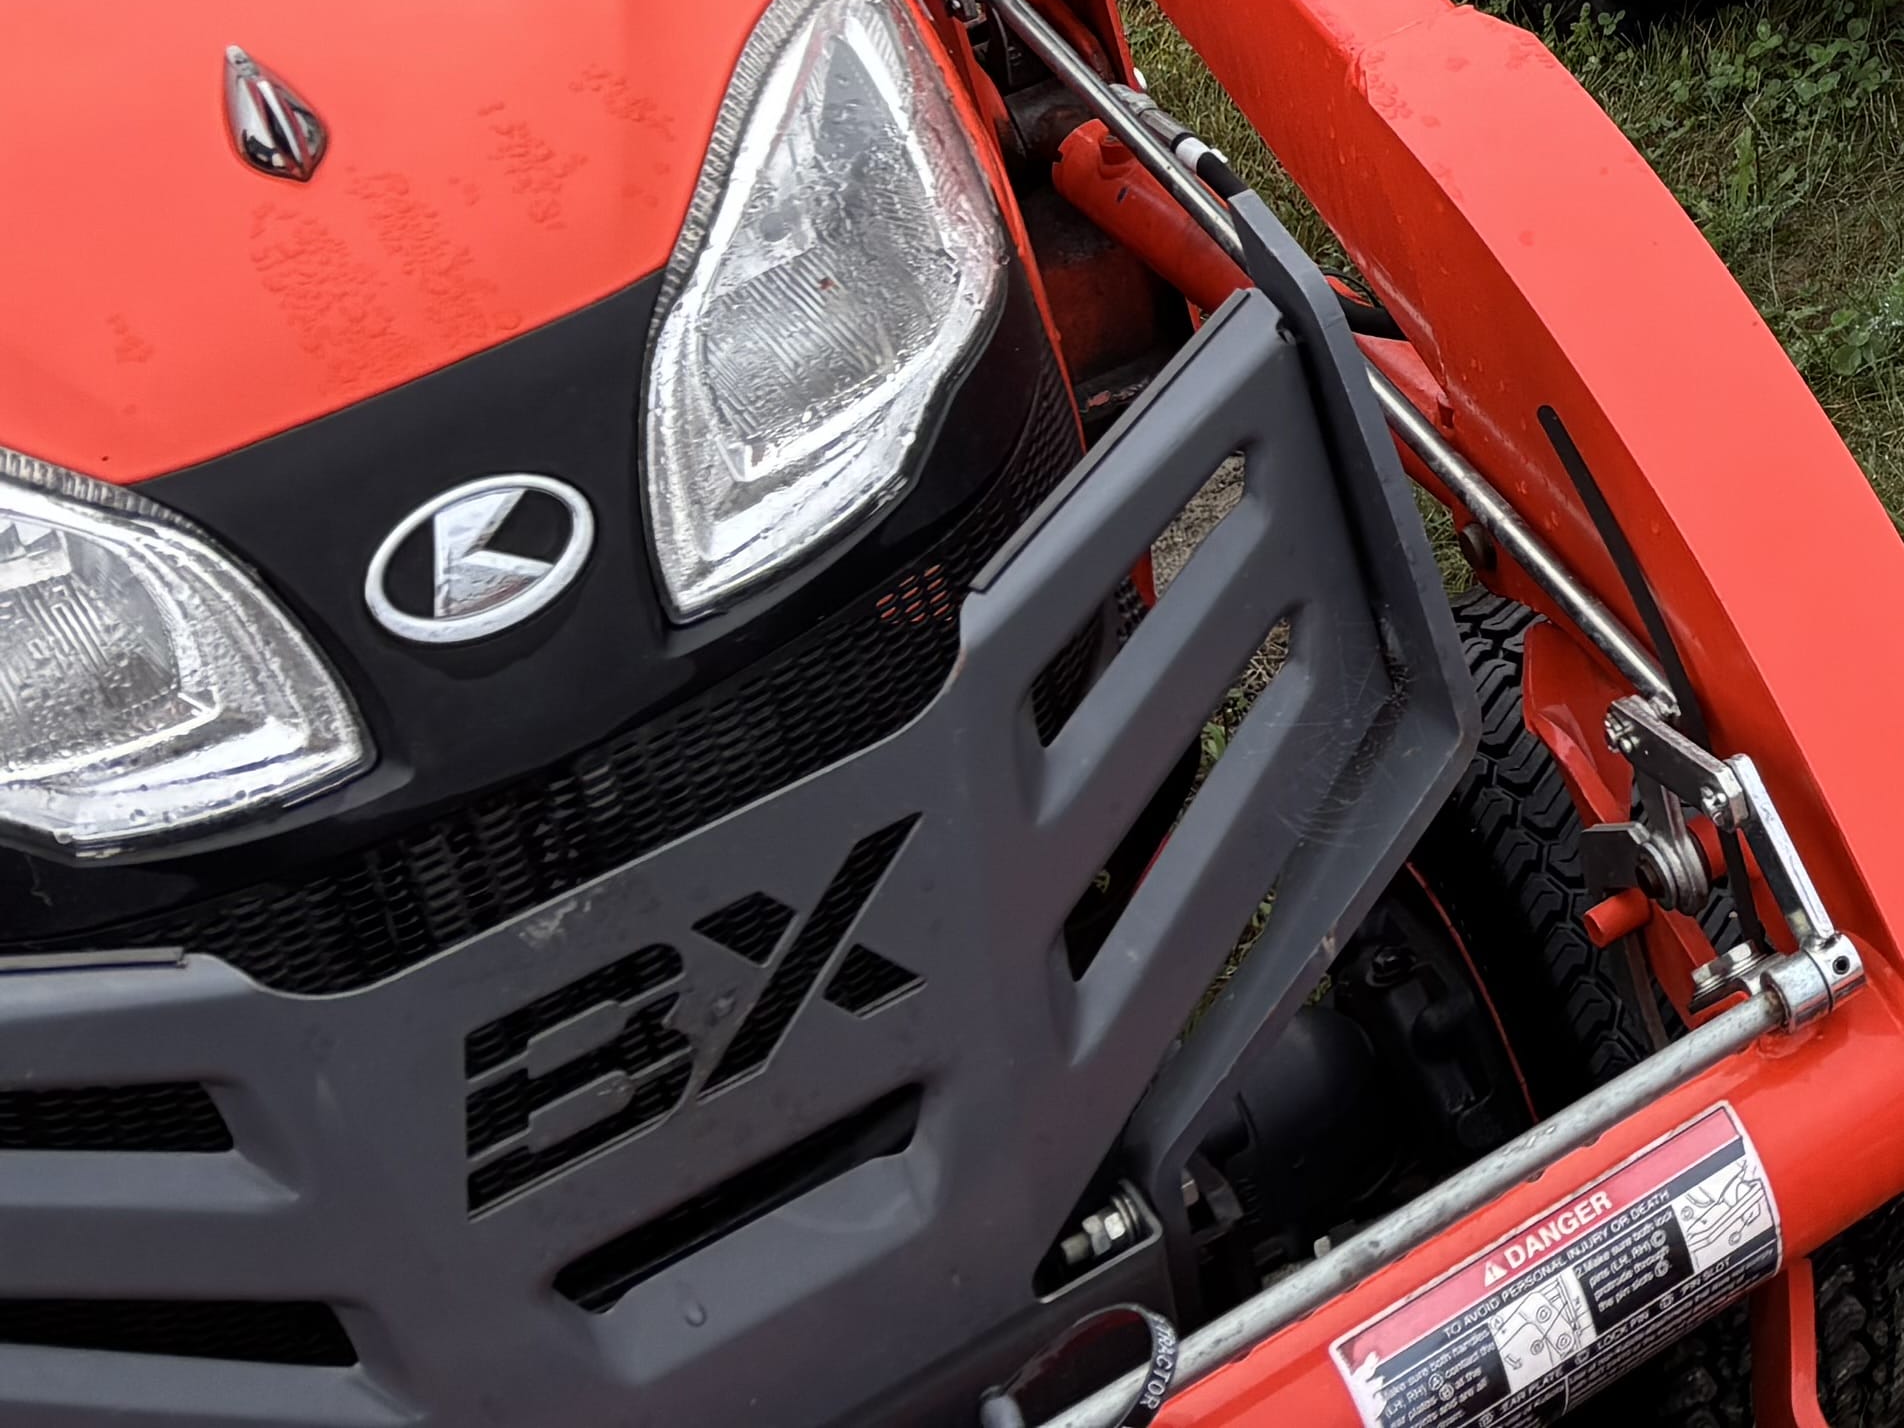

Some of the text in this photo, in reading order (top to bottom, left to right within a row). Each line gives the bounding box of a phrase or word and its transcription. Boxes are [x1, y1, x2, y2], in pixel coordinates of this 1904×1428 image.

[464, 810, 928, 1222] BX
[1445, 1190, 1670, 1339] TO AVOID PERSONAL INJURY OR DEATH
[1504, 1191, 1613, 1269] DANGER
